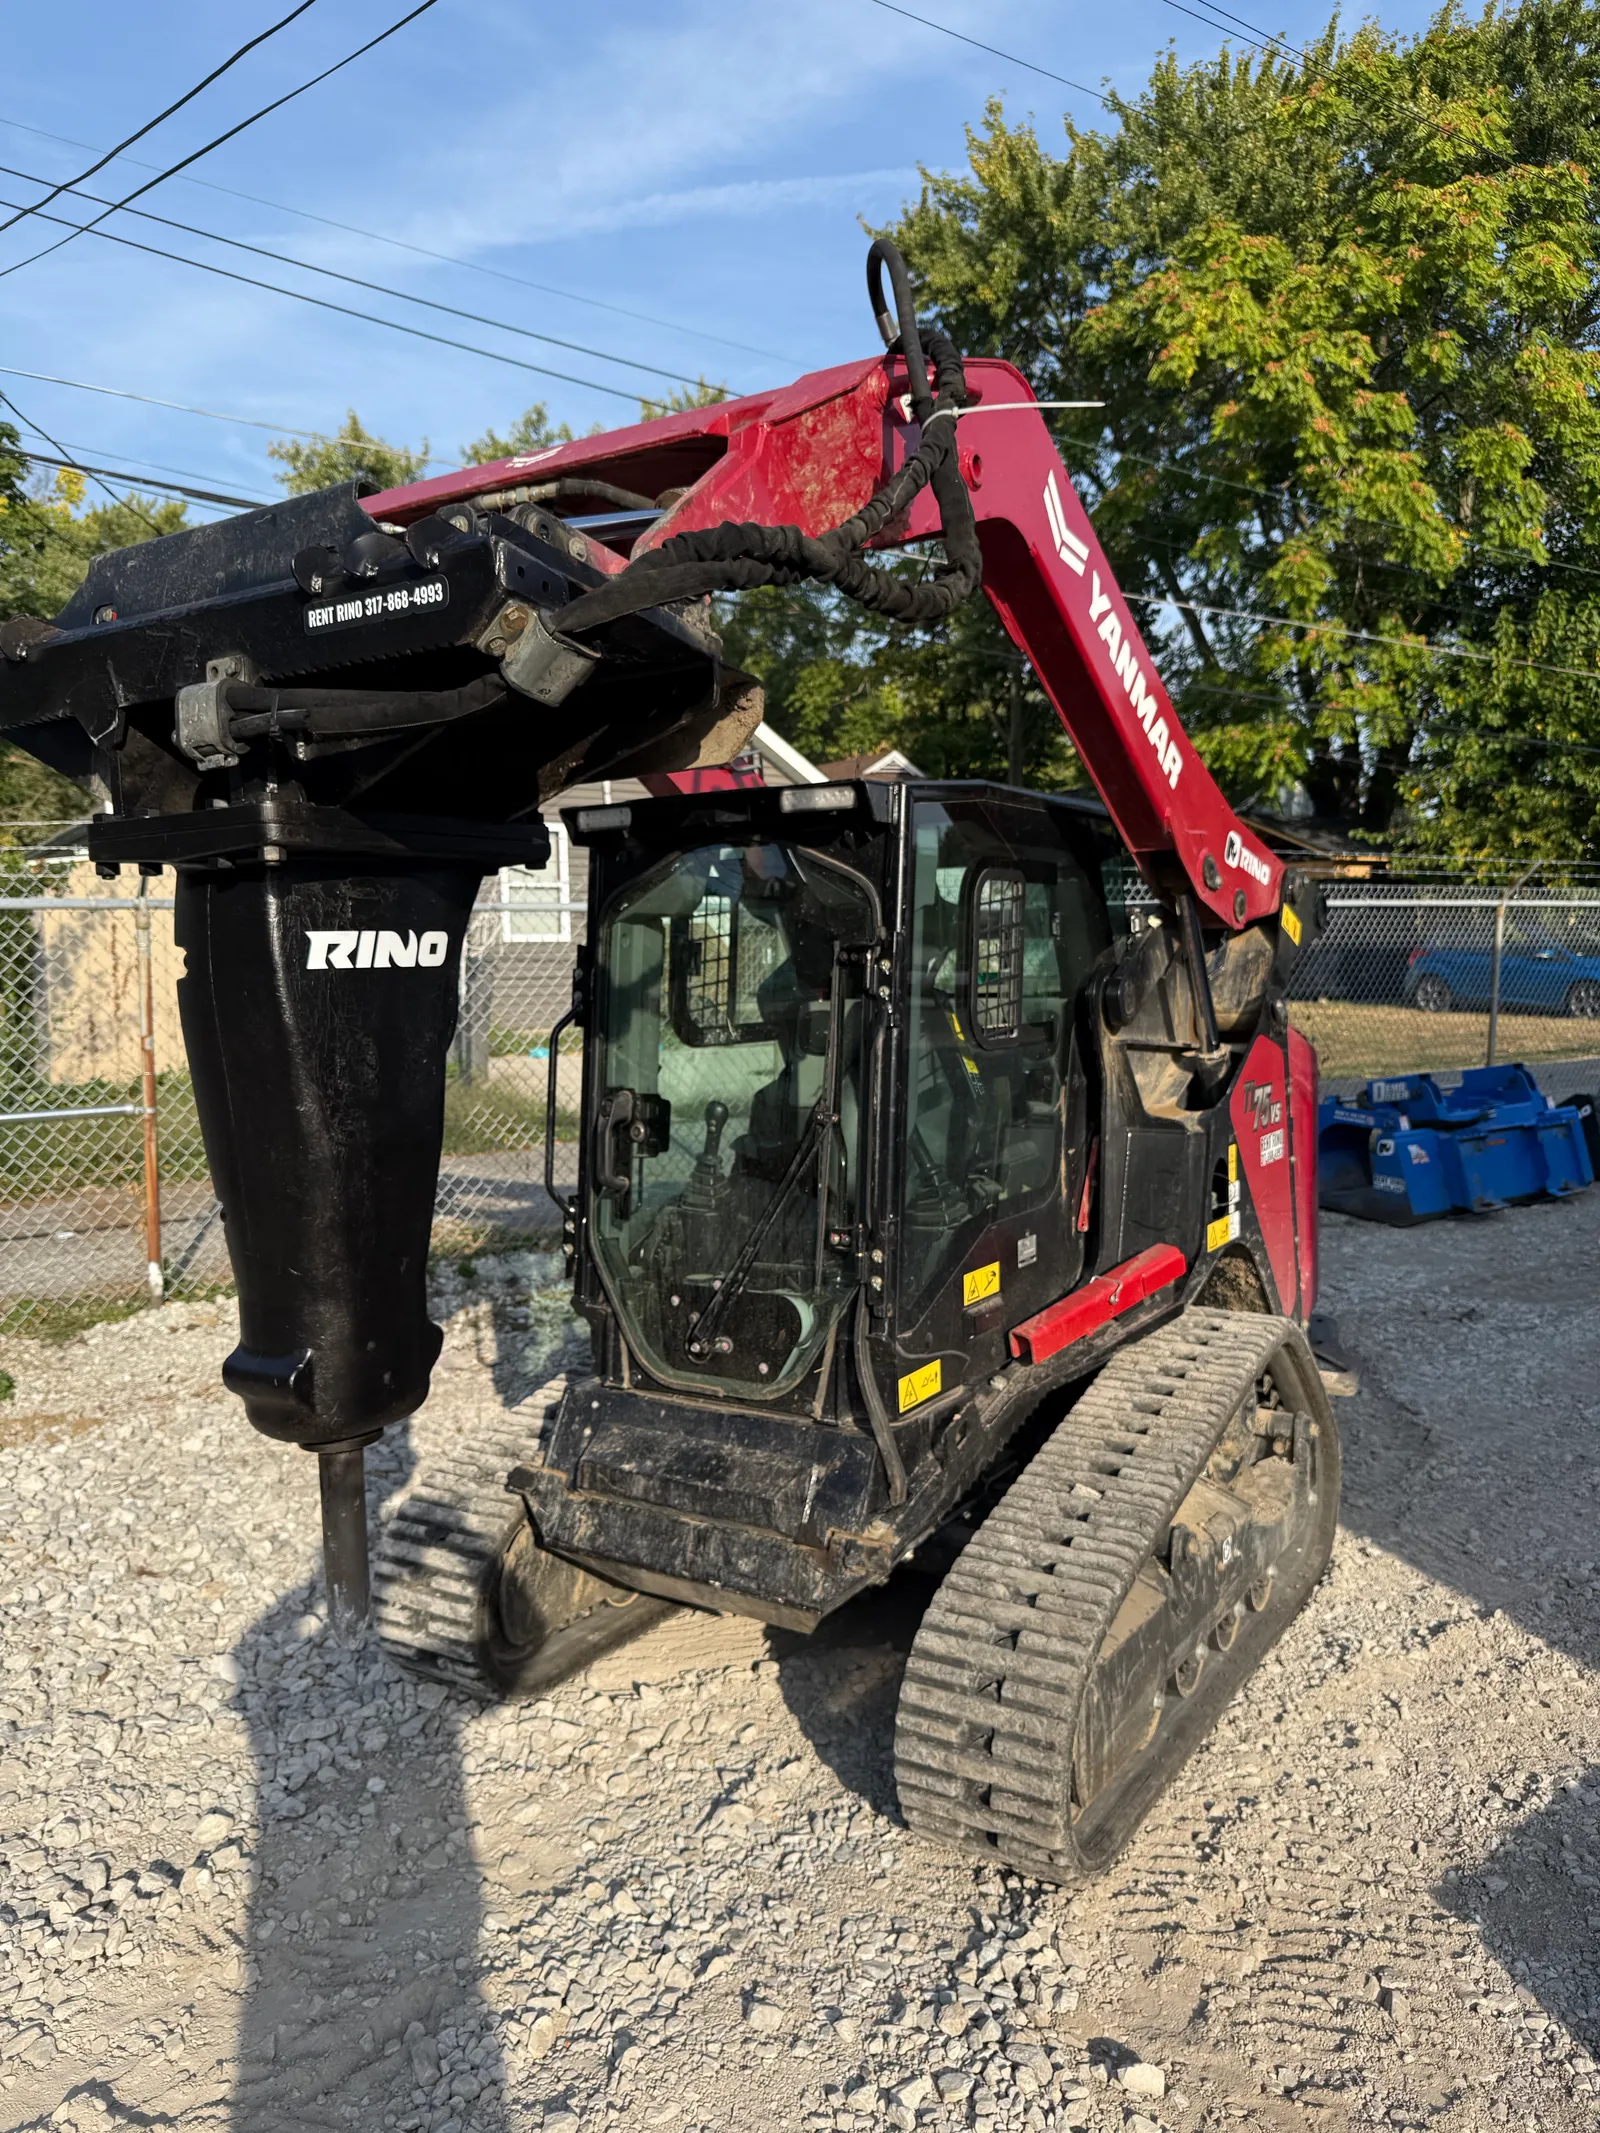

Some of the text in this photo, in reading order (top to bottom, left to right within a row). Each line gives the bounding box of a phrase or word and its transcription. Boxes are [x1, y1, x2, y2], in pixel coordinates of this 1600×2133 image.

[307, 582, 444, 628] RENT RINO 317-868-4993
[1088, 569, 1183, 790] YANMAR
[1240, 846, 1271, 886] RINO
[304, 929, 449, 970] RINO
